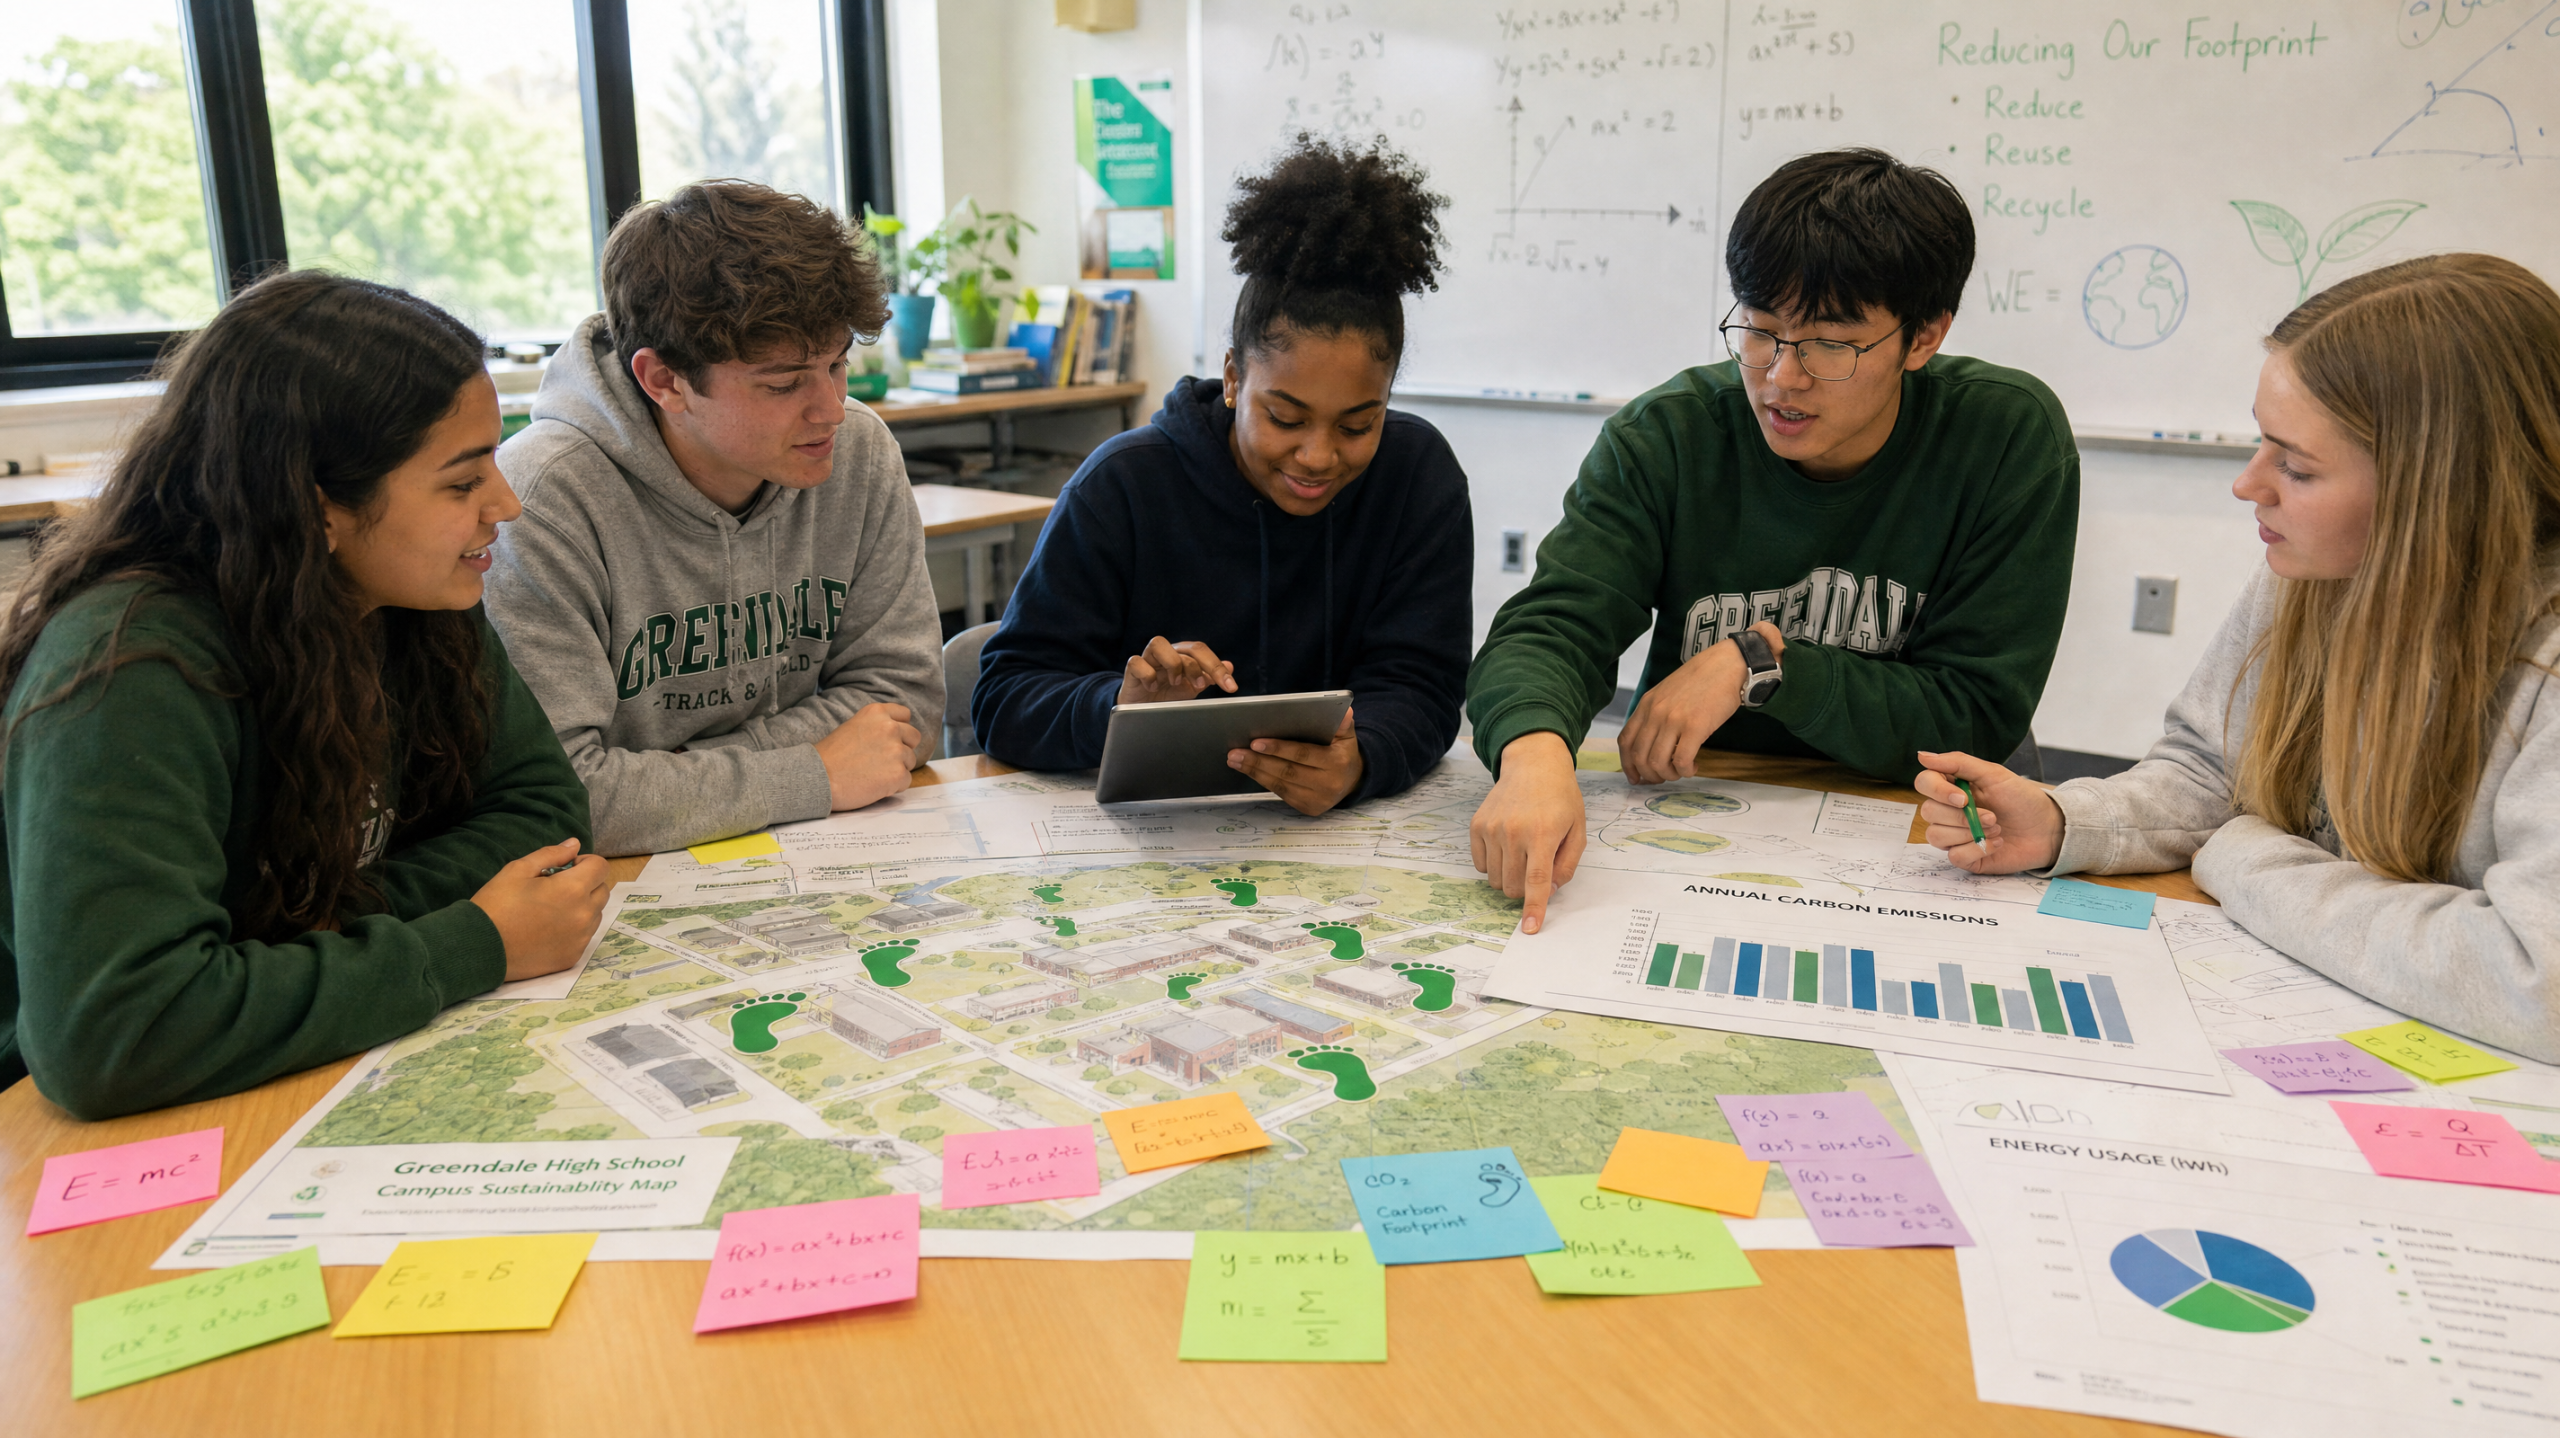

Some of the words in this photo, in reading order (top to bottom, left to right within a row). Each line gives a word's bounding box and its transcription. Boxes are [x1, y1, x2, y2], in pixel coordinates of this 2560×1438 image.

[1938, 21, 2075, 81] Reducing
[2103, 18, 2161, 60] Our
[2184, 16, 2329, 73] Footprint
[1984, 85, 2086, 120] Reduce
[1984, 132, 2073, 166] Reuse
[1983, 183, 2095, 237] Recycle
[1983, 268, 2035, 314] WE
[663, 687, 734, 710] TRACK
[744, 682, 757, 701] &
[1684, 884, 1773, 902] ANNUAL
[1777, 895, 1871, 914] CARBON
[1877, 907, 2000, 927] EMISSIONS
[393, 1159, 538, 1175] Greendale
[544, 1158, 600, 1175] High
[606, 1155, 686, 1171] School
[1989, 1137, 2081, 1157] ENERGY
[2088, 1148, 2167, 1167] USAGE
[62, 1171, 97, 1201] E
[376, 1183, 473, 1199] Campus
[630, 1178, 678, 1193] Map
[1376, 1203, 1448, 1219] Carbon
[1382, 1215, 1468, 1236] Footprint
[726, 1242, 767, 1262] f(x)
[1220, 1253, 1236, 1279] y
